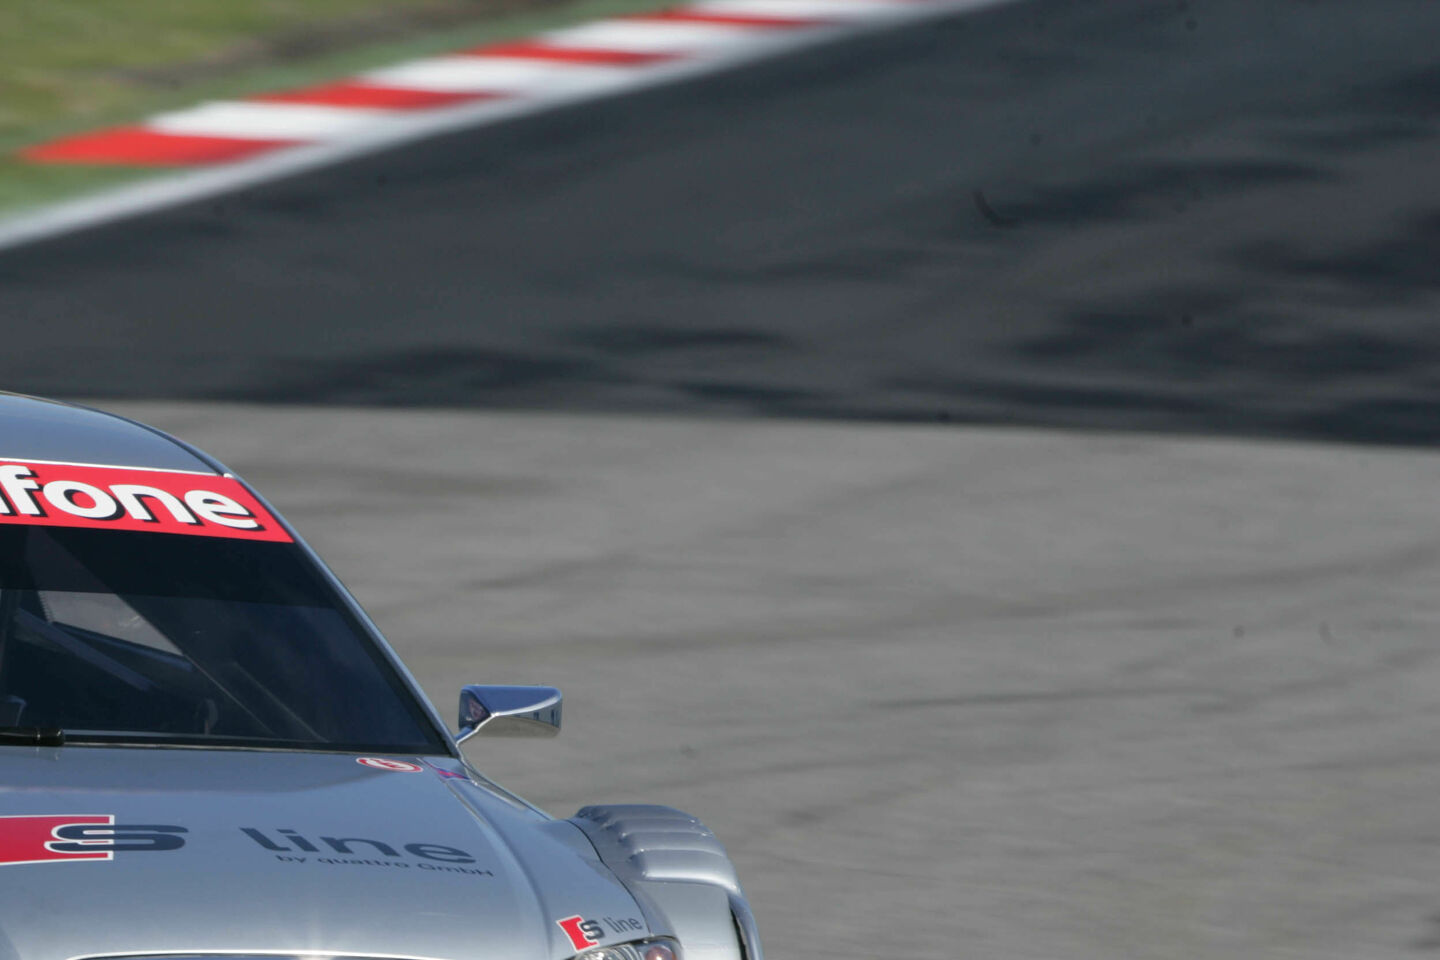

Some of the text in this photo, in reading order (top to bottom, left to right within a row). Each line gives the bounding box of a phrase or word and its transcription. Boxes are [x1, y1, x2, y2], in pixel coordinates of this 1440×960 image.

[239, 827, 477, 864] line
[276, 854, 495, 878] by quattro GmbH
[602, 915, 643, 935] line
